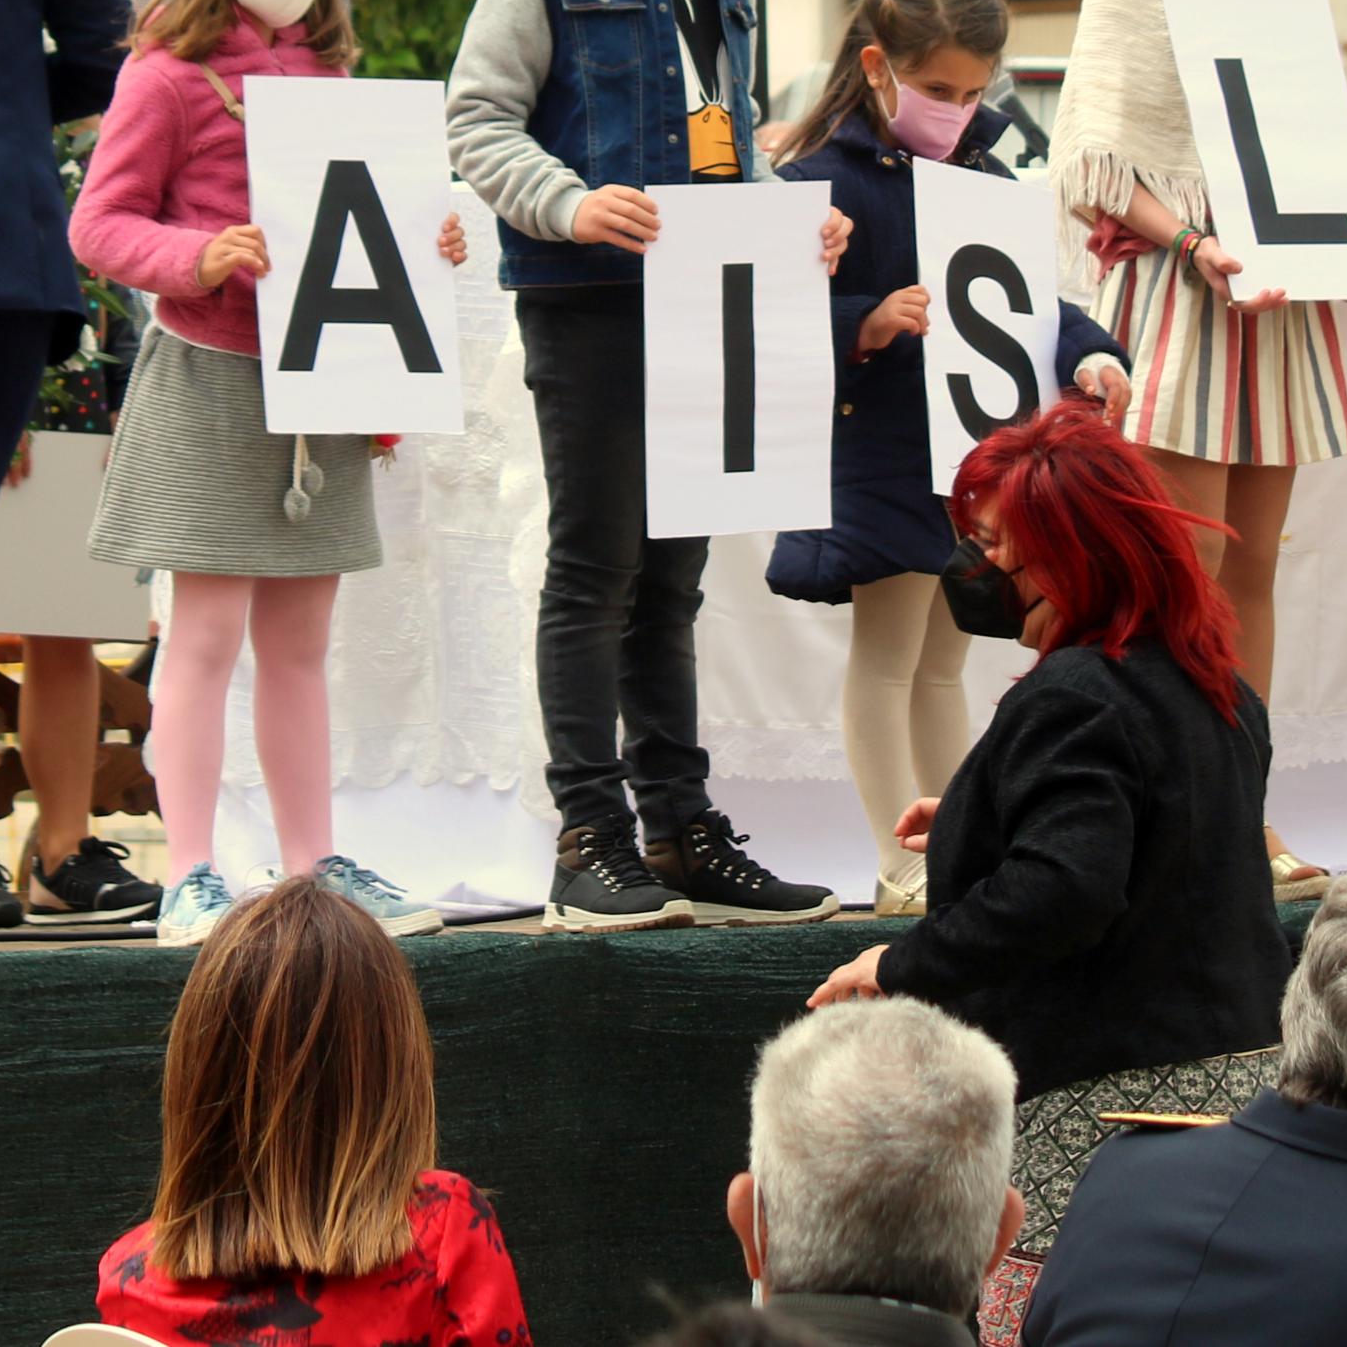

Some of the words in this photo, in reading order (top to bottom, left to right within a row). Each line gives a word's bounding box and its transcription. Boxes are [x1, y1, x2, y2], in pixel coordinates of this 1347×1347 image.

[278, 160, 443, 374] A
[722, 263, 756, 474] I
[945, 243, 1040, 445] S
